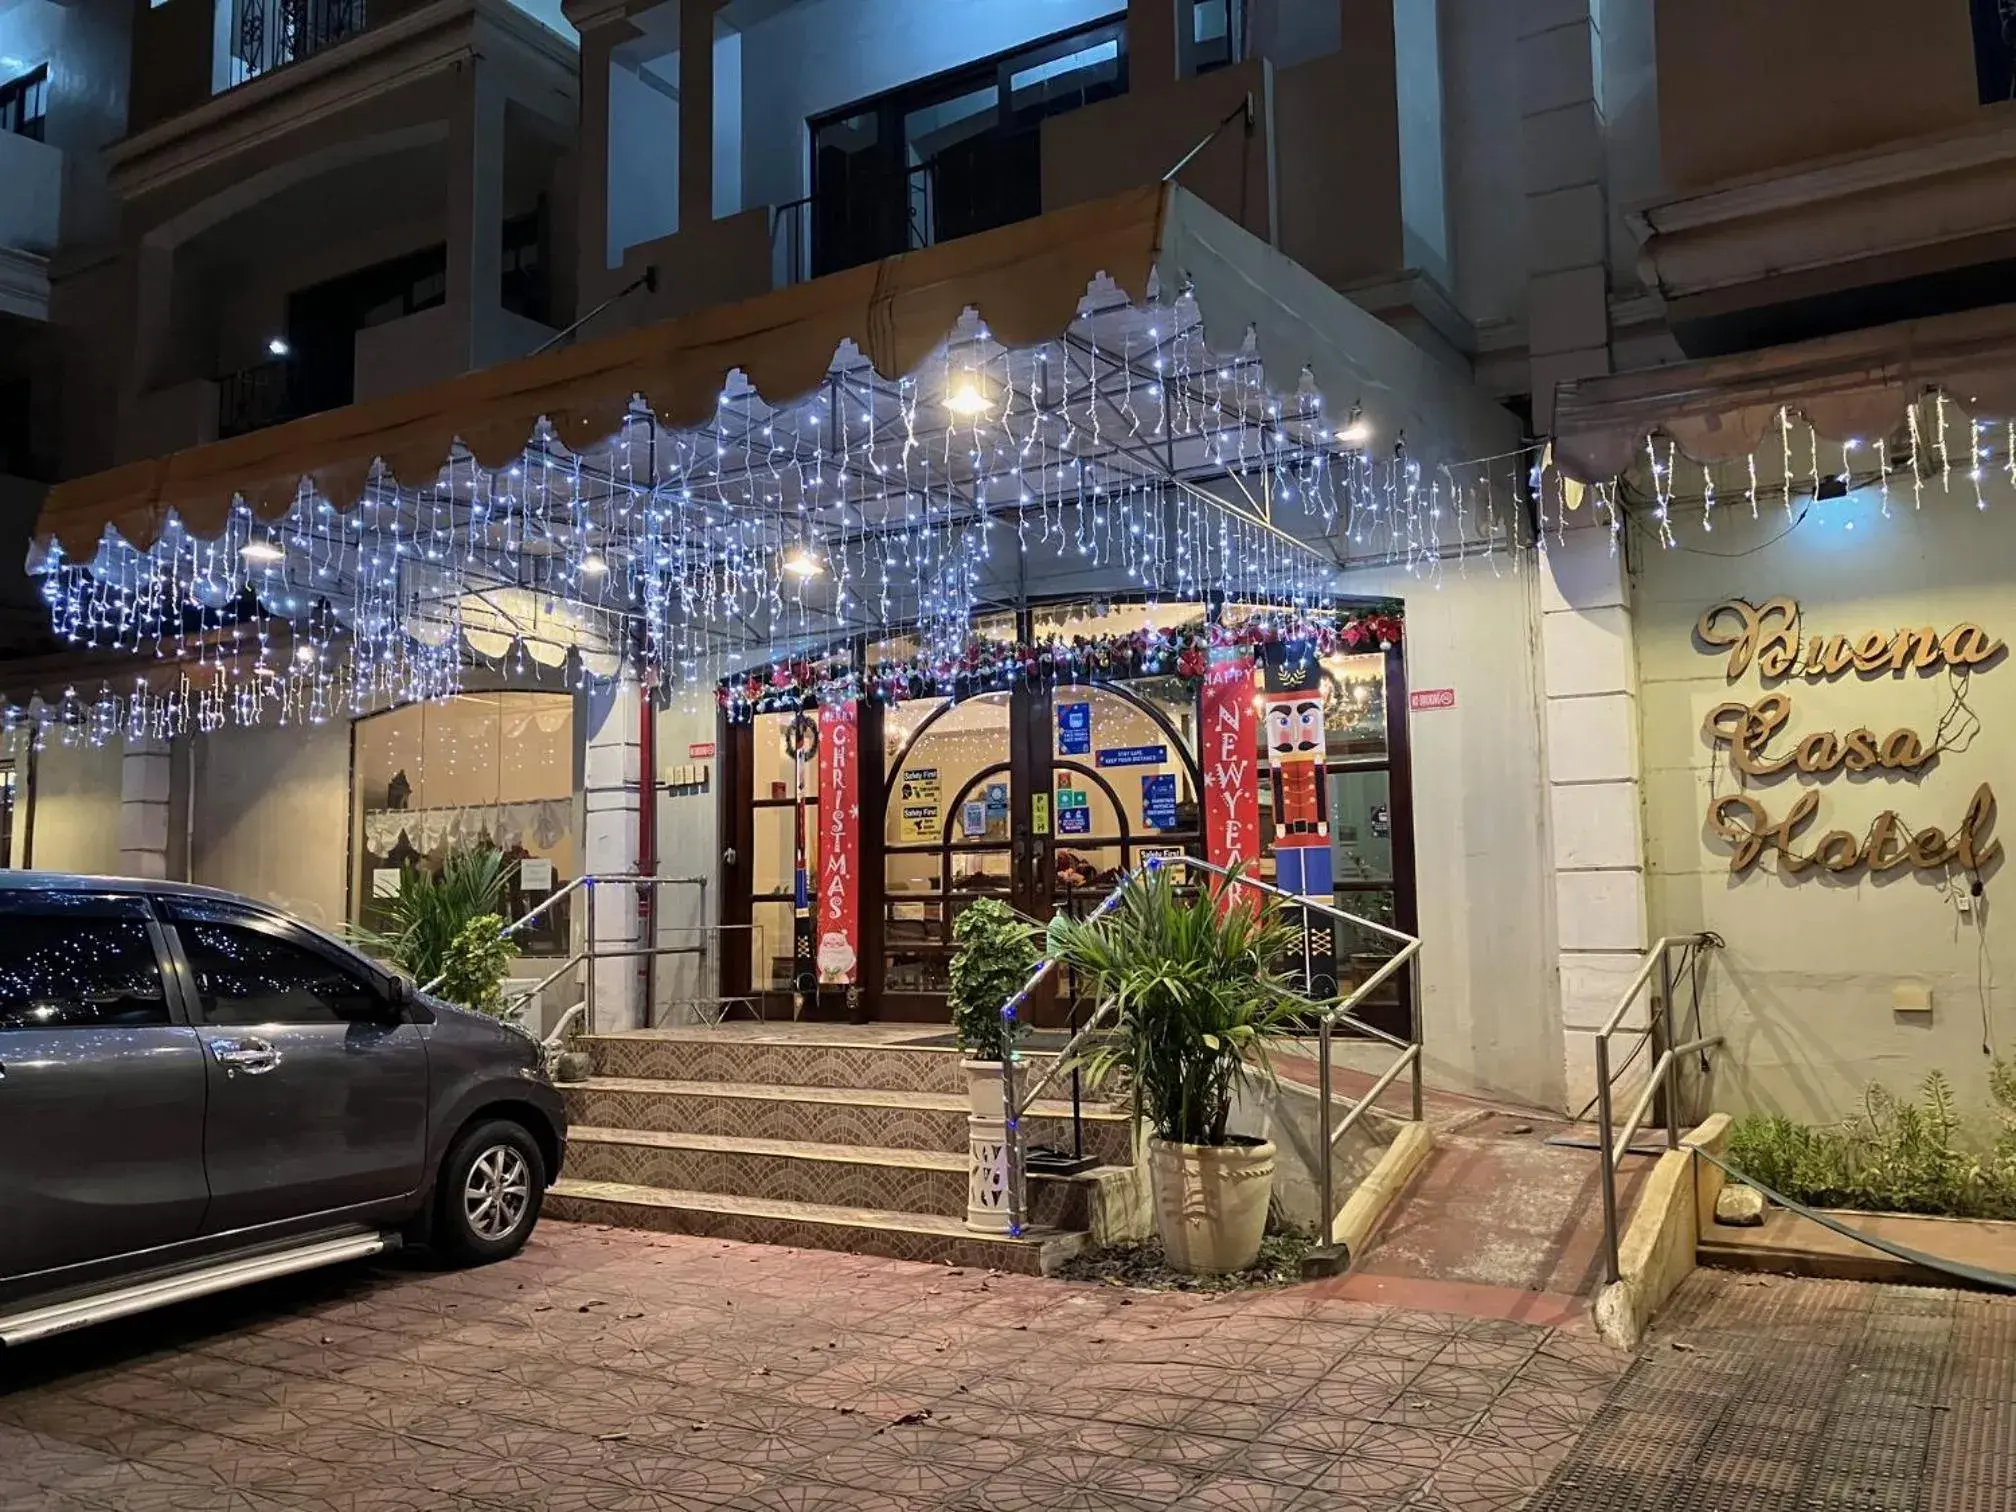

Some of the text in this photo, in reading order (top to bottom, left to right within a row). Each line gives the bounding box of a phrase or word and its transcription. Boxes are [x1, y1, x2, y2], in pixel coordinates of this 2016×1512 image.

[1698, 596, 2002, 677] Buena
[1704, 692, 1941, 775] Casa
[824, 724, 848, 920] CHRISTMAS
[1707, 782, 2001, 873] Hotel
